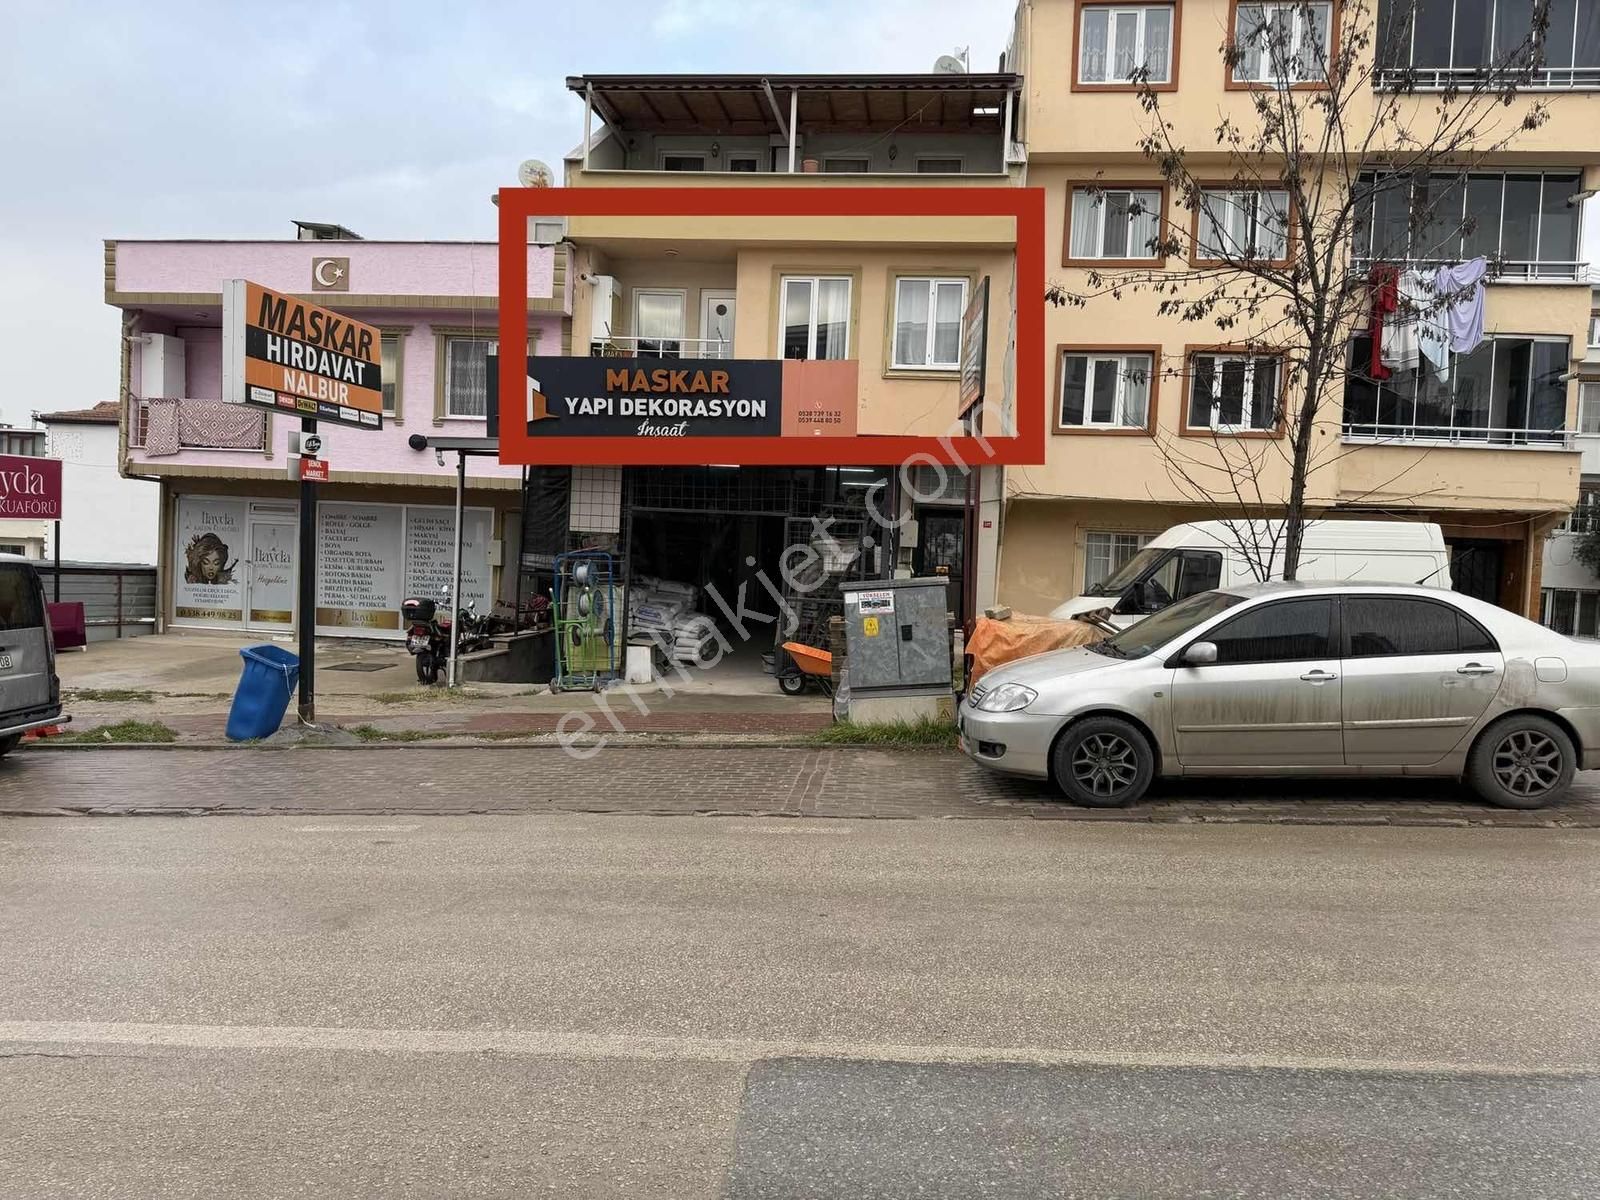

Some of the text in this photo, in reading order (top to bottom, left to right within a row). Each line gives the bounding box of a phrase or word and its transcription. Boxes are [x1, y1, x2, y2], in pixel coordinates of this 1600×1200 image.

[258, 292, 373, 361] MASKAR
[266, 333, 366, 385] HIRDAVAT
[283, 368, 349, 405] NALBUR
[606, 368, 730, 393] MASKAR
[565, 397, 766, 417] YAPI DEKORASYON
[0, 499, 57, 514] KUAFÖRÜ
